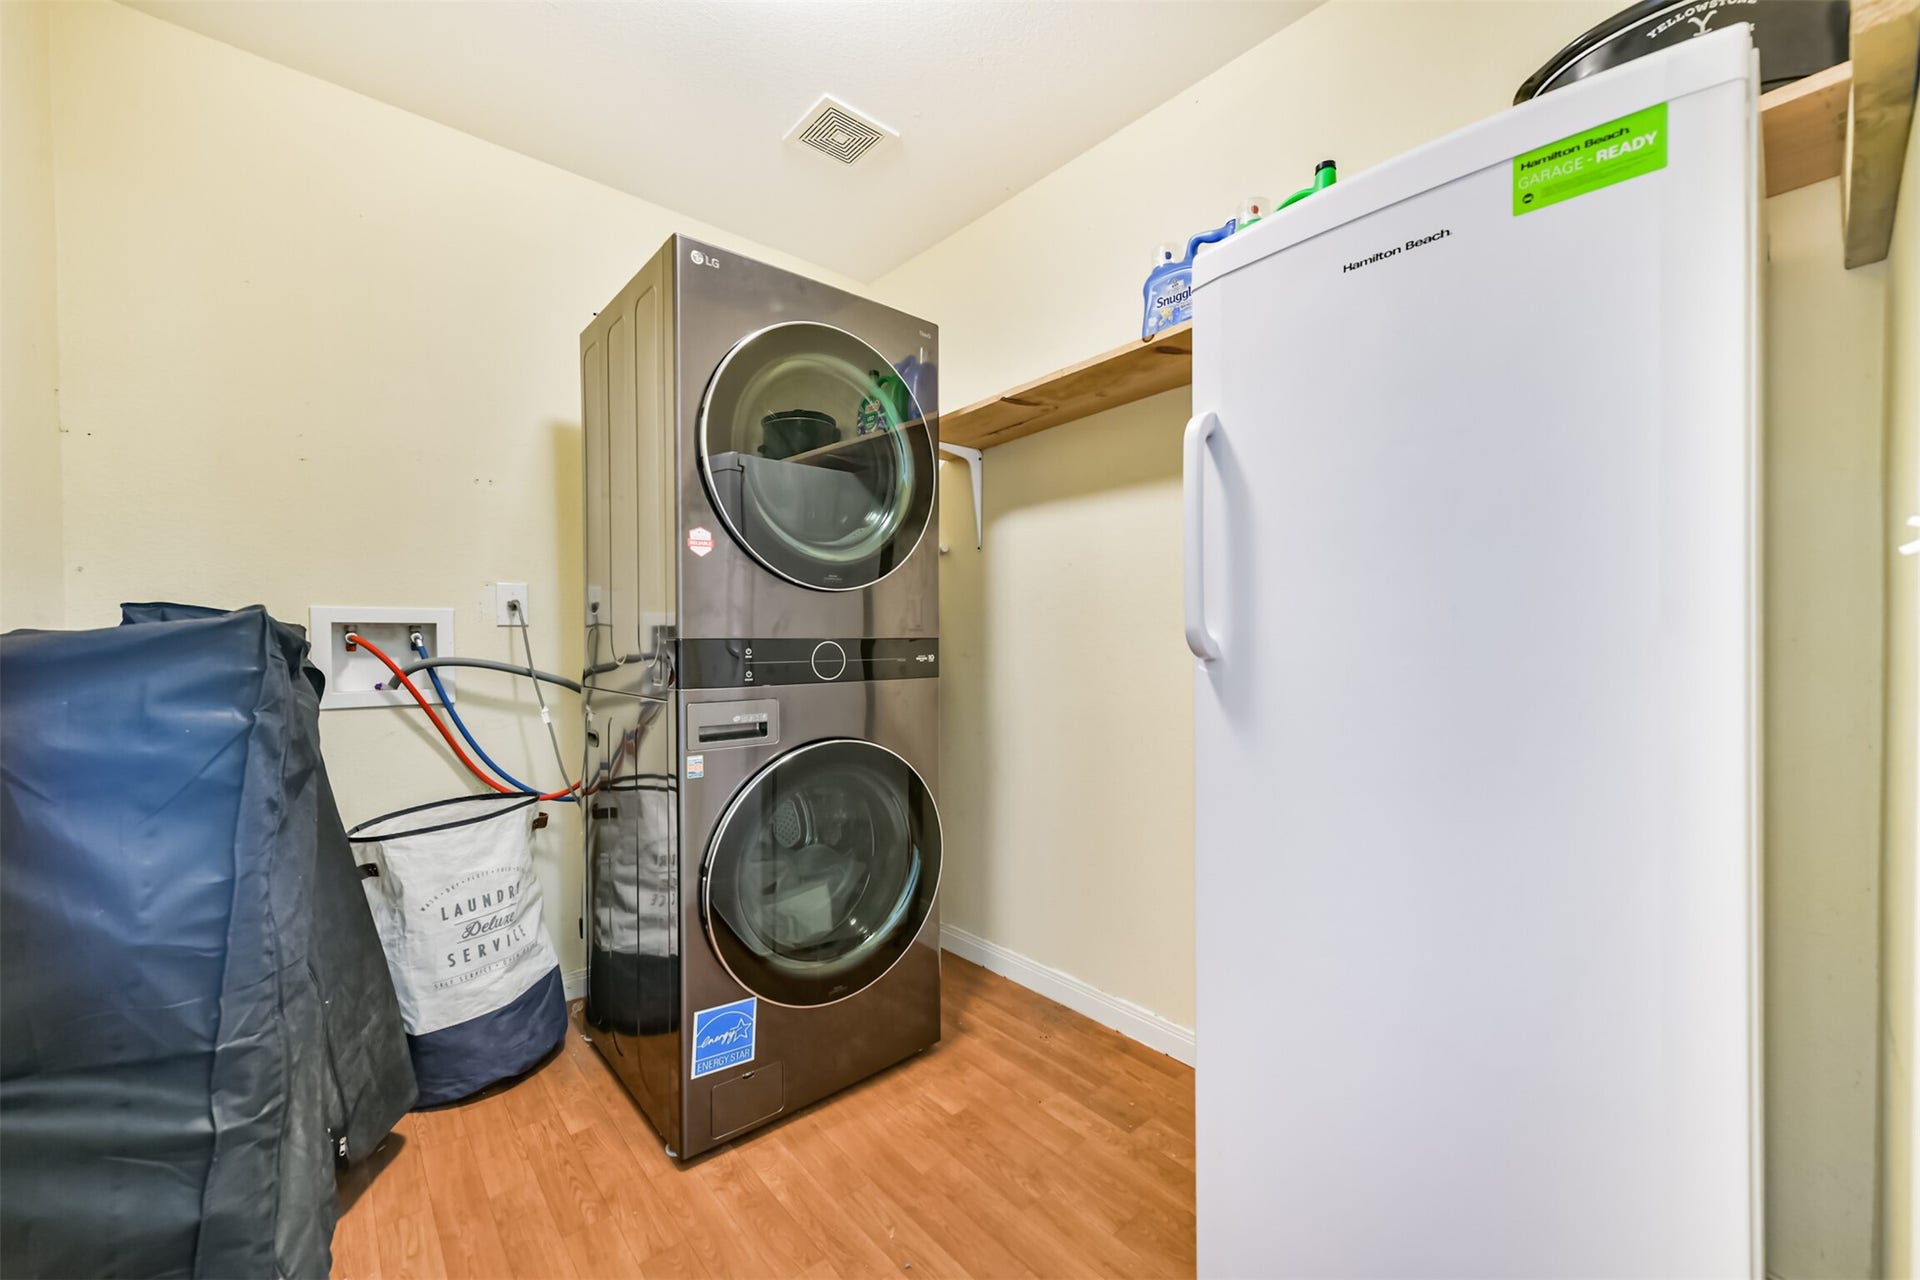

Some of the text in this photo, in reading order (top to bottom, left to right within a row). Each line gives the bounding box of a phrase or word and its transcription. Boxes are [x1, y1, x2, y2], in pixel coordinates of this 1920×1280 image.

[1518, 156, 1584, 190] GARAGE
[1595, 130, 1658, 164] READY
[1520, 127, 1630, 171] Hamilton Beach
[1342, 228, 1451, 273] Hamilton Beach
[1156, 285, 1192, 309] Snuggl
[461, 911, 515, 939] Deluxe
[696, 1047, 751, 1073] ENERGY STAR
